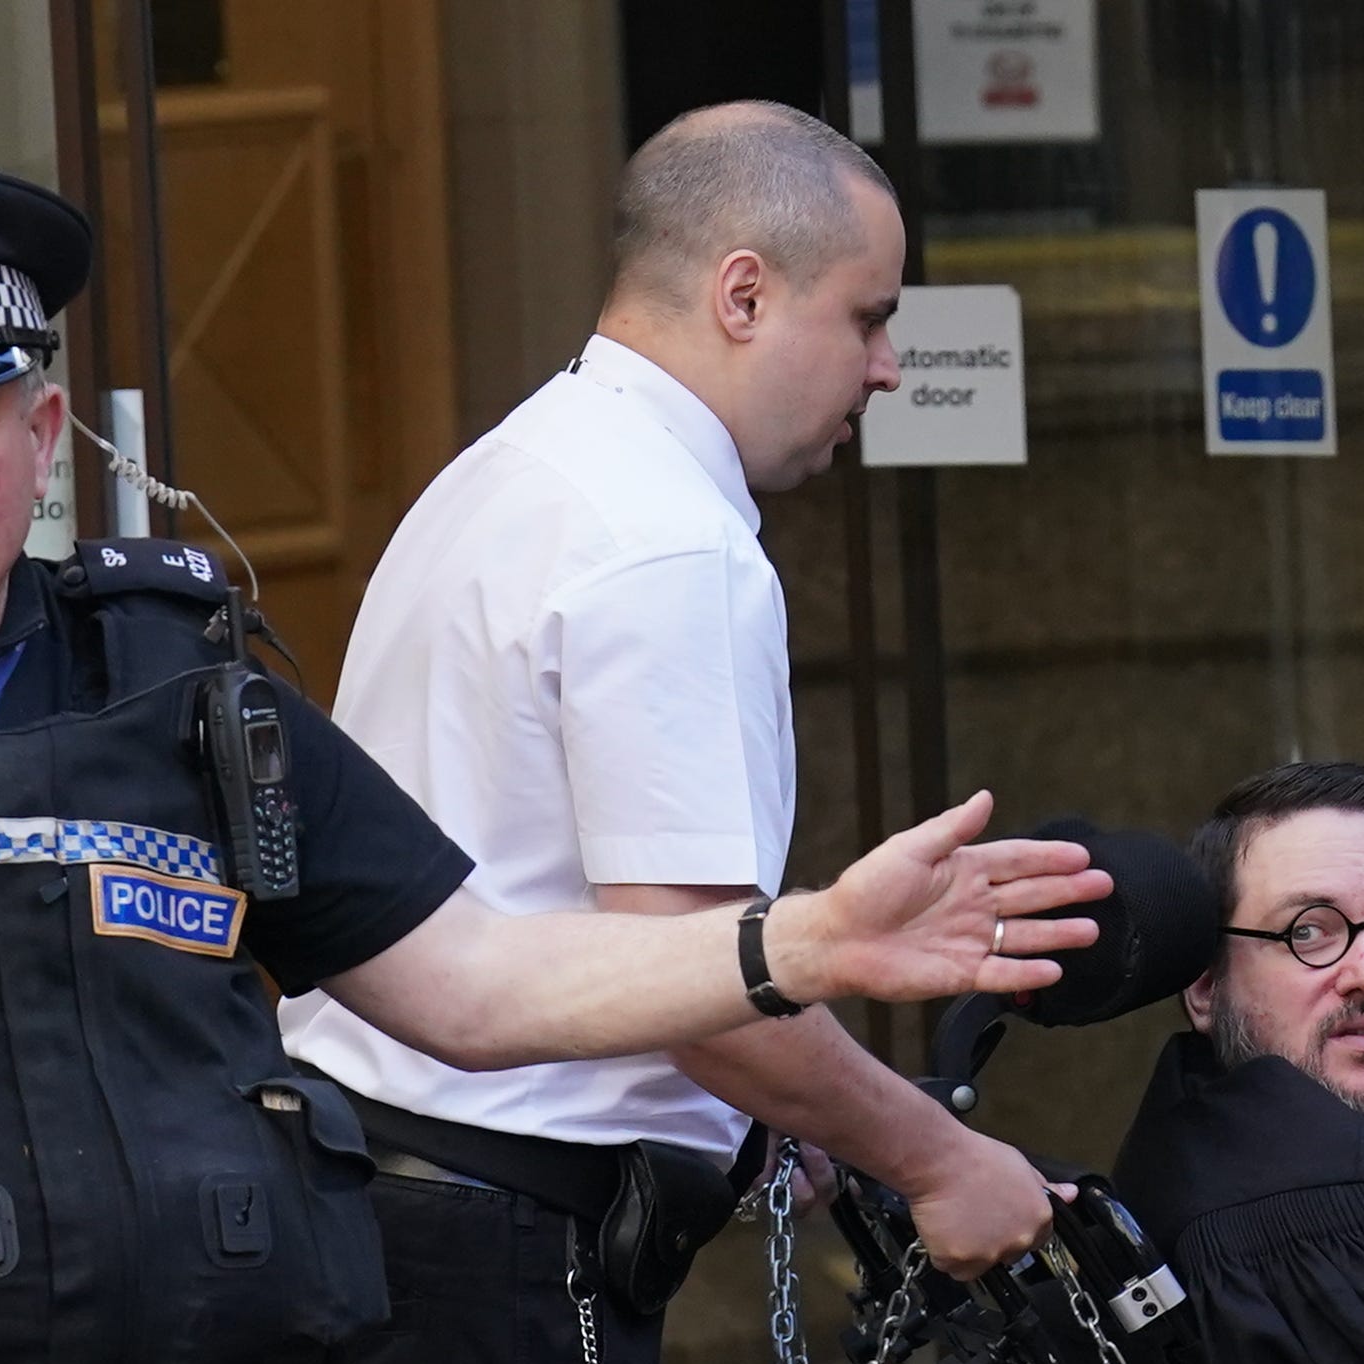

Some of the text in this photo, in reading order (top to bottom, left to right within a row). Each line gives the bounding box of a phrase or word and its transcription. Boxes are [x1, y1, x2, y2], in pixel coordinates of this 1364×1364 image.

[898, 345, 1010, 369] utomatic
[911, 384, 976, 406] door
[1220, 391, 1322, 423] Keep clear
[100, 547, 127, 568] SP
[162, 554, 186, 568] E
[183, 547, 215, 582] 4227
[111, 882, 228, 936] POLICE
